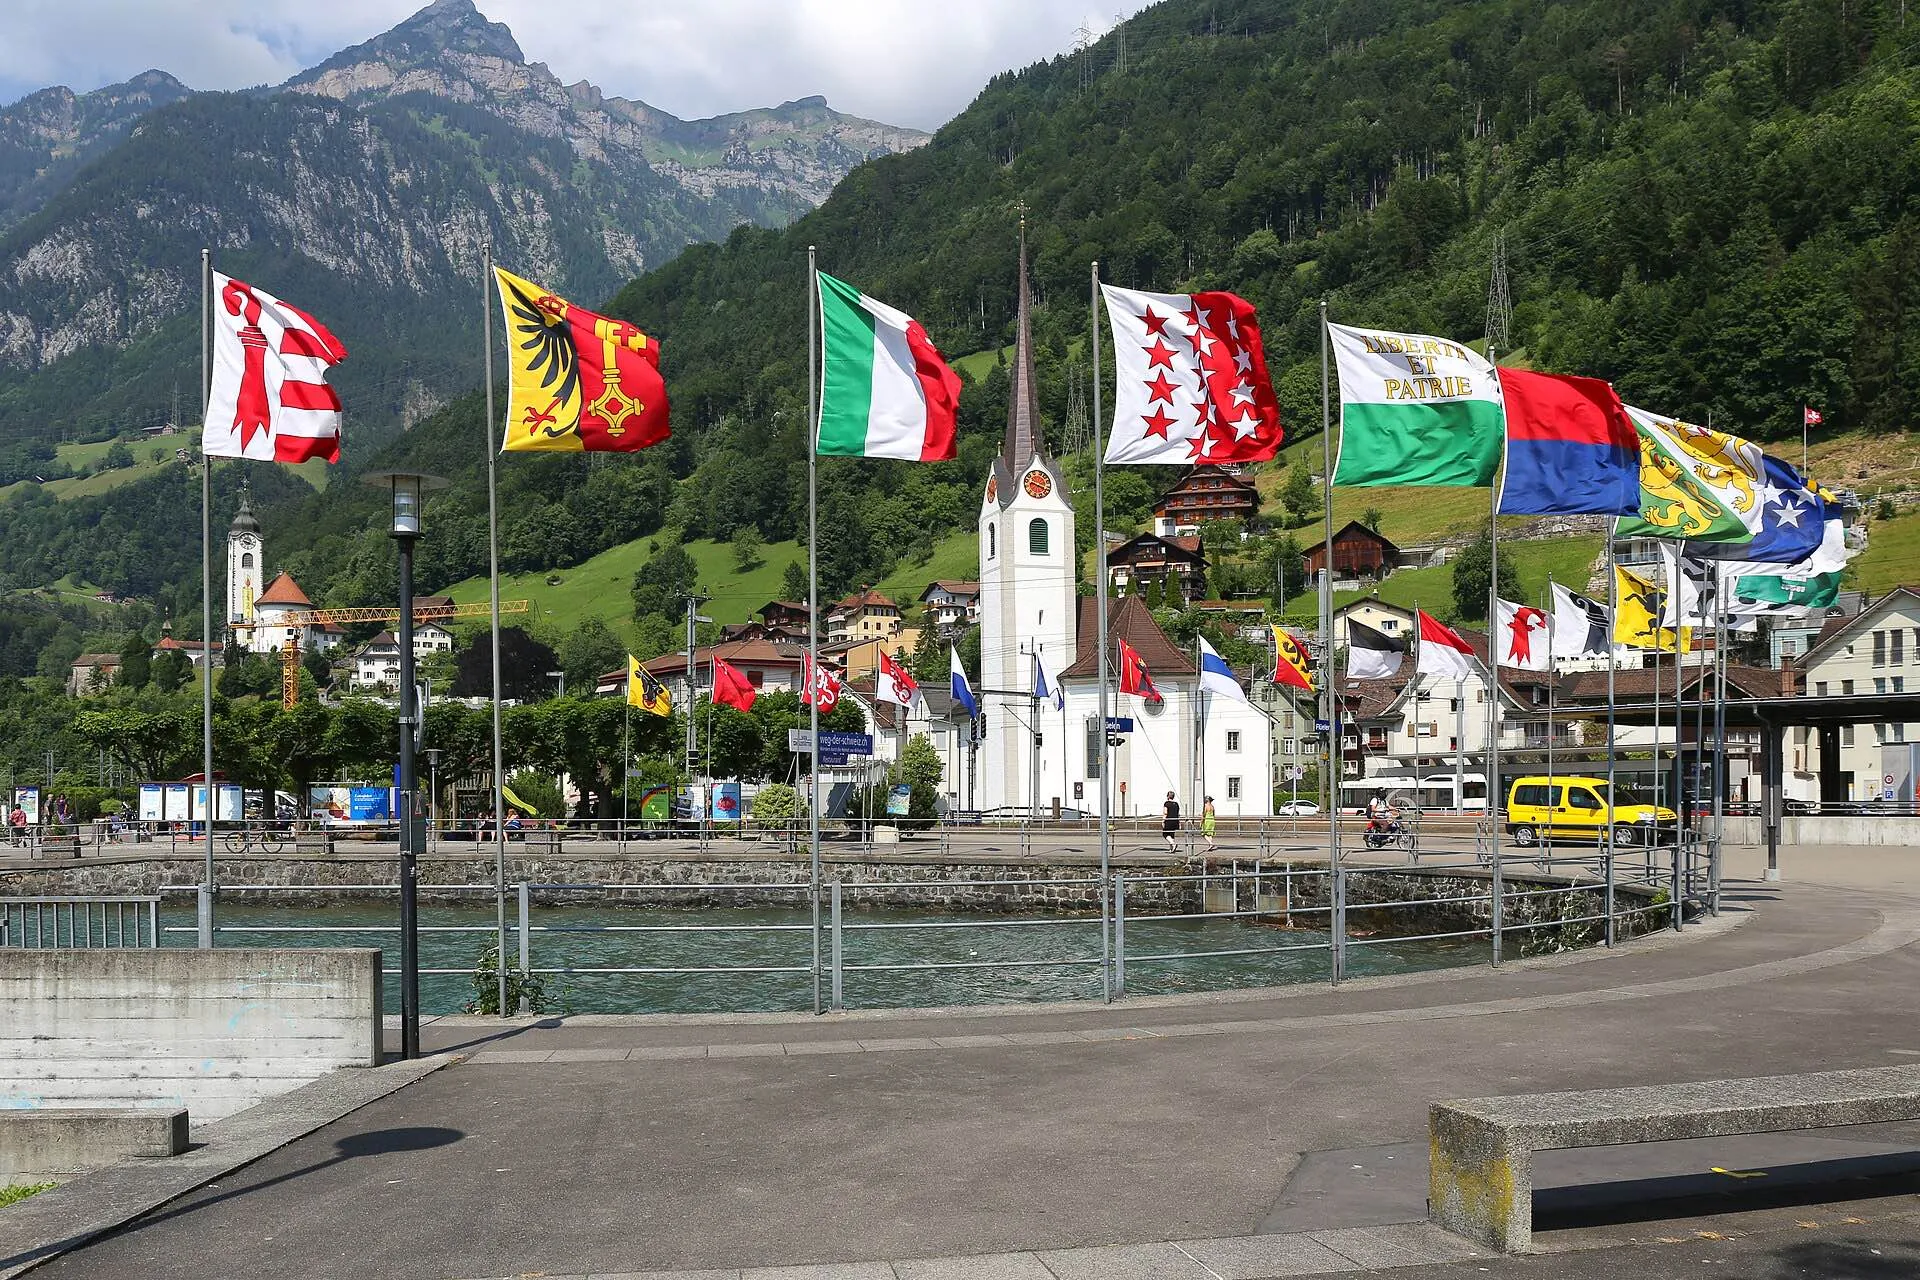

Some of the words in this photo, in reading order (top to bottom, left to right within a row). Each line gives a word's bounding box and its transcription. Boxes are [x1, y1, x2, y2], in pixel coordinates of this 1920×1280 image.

[1405, 355, 1437, 375] ET
[1384, 376, 1472, 399] PATRIE
[819, 734, 868, 747] weg-der-schweiz.ch
